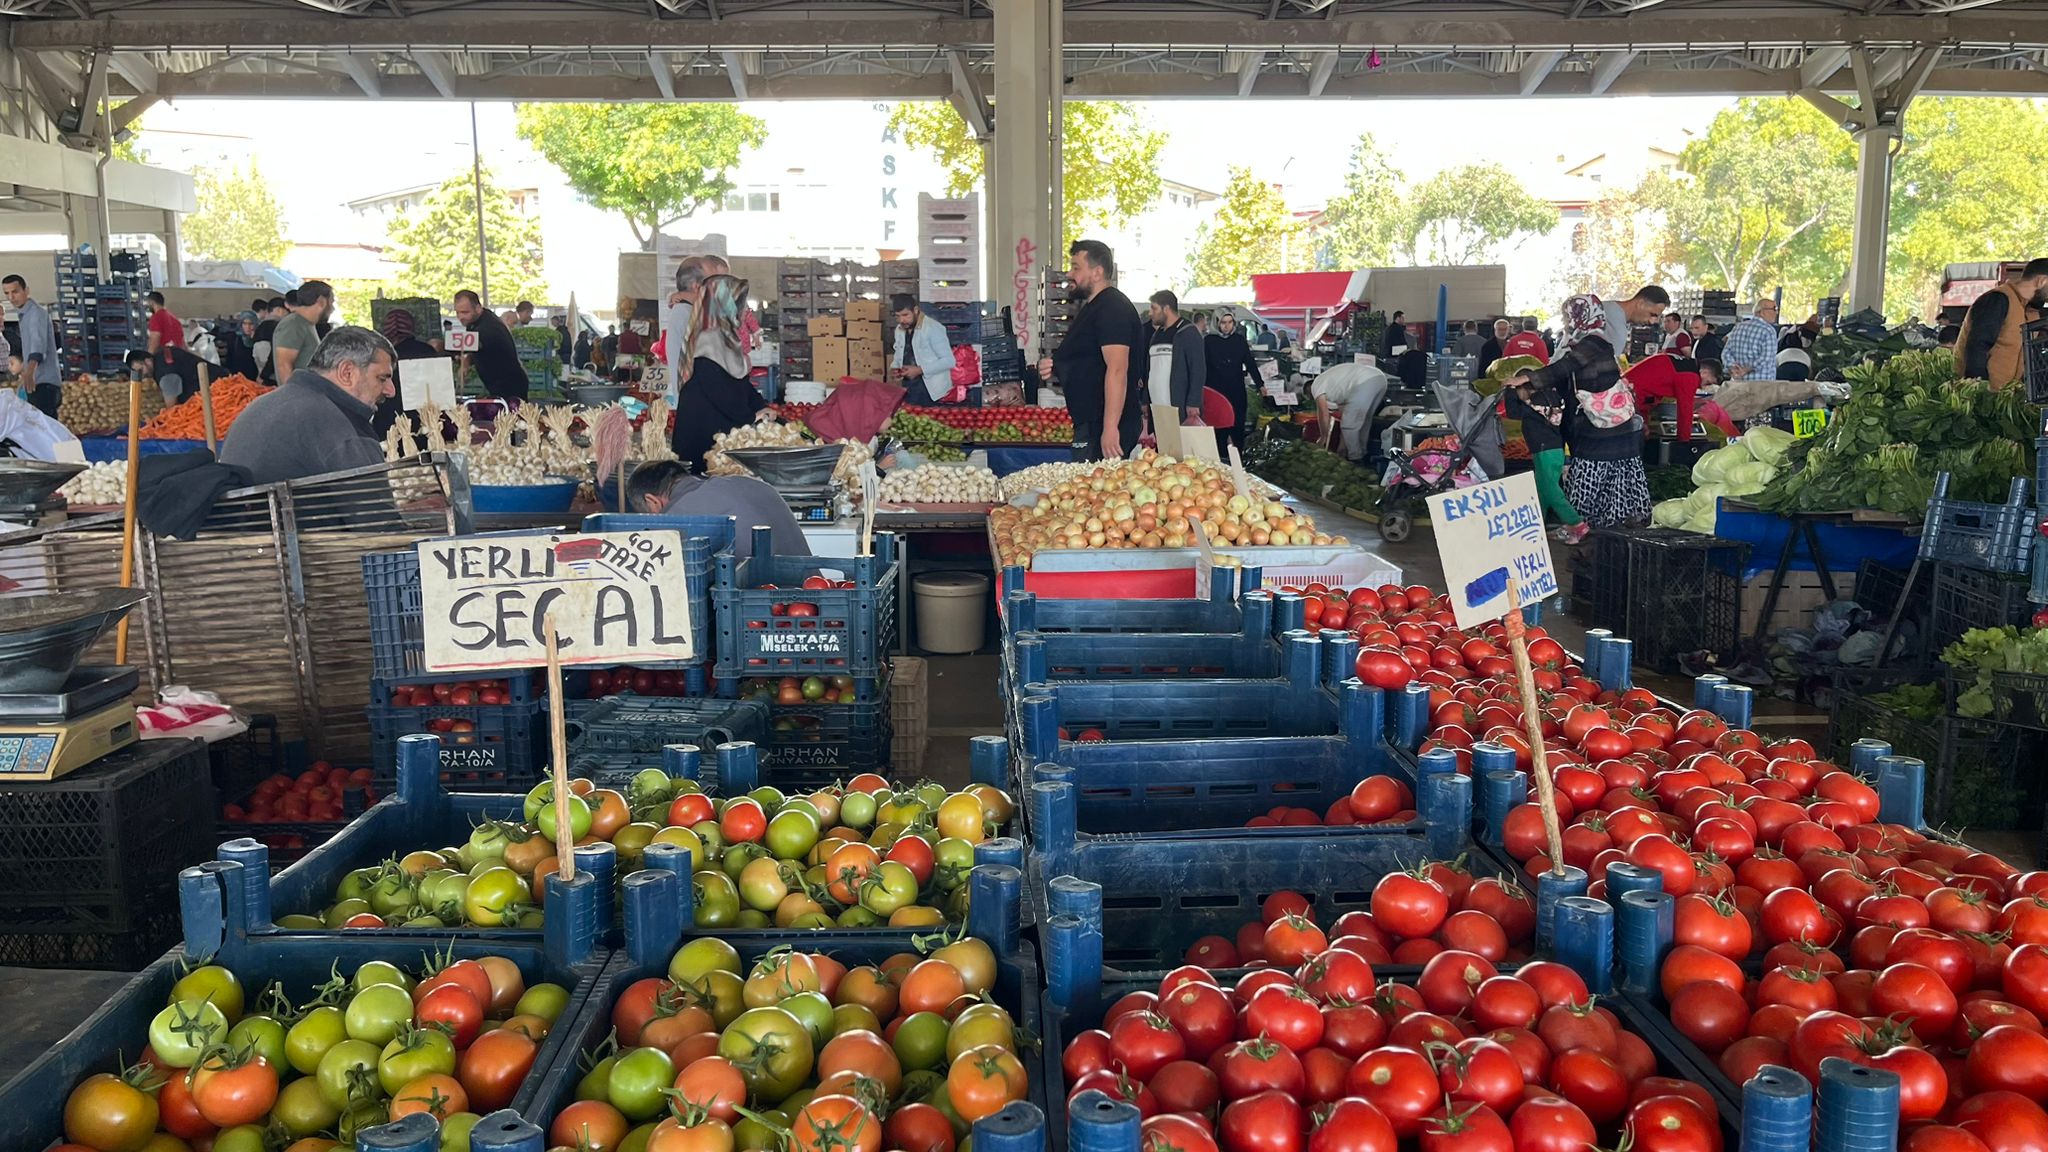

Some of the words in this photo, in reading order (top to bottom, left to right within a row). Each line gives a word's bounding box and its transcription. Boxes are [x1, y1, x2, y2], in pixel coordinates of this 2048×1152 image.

[452, 333, 475, 349] 50
[646, 367, 667, 381] 35
[1799, 418, 1822, 435] 100
[594, 584, 687, 647] AL
[760, 634, 840, 652] MUSTAFA
[774, 644, 809, 652] SELEK
[817, 644, 840, 652] 19/A
[439, 748, 495, 760] RHAN
[769, 747, 839, 757] URHAN
[440, 759, 494, 767] YA-10/A
